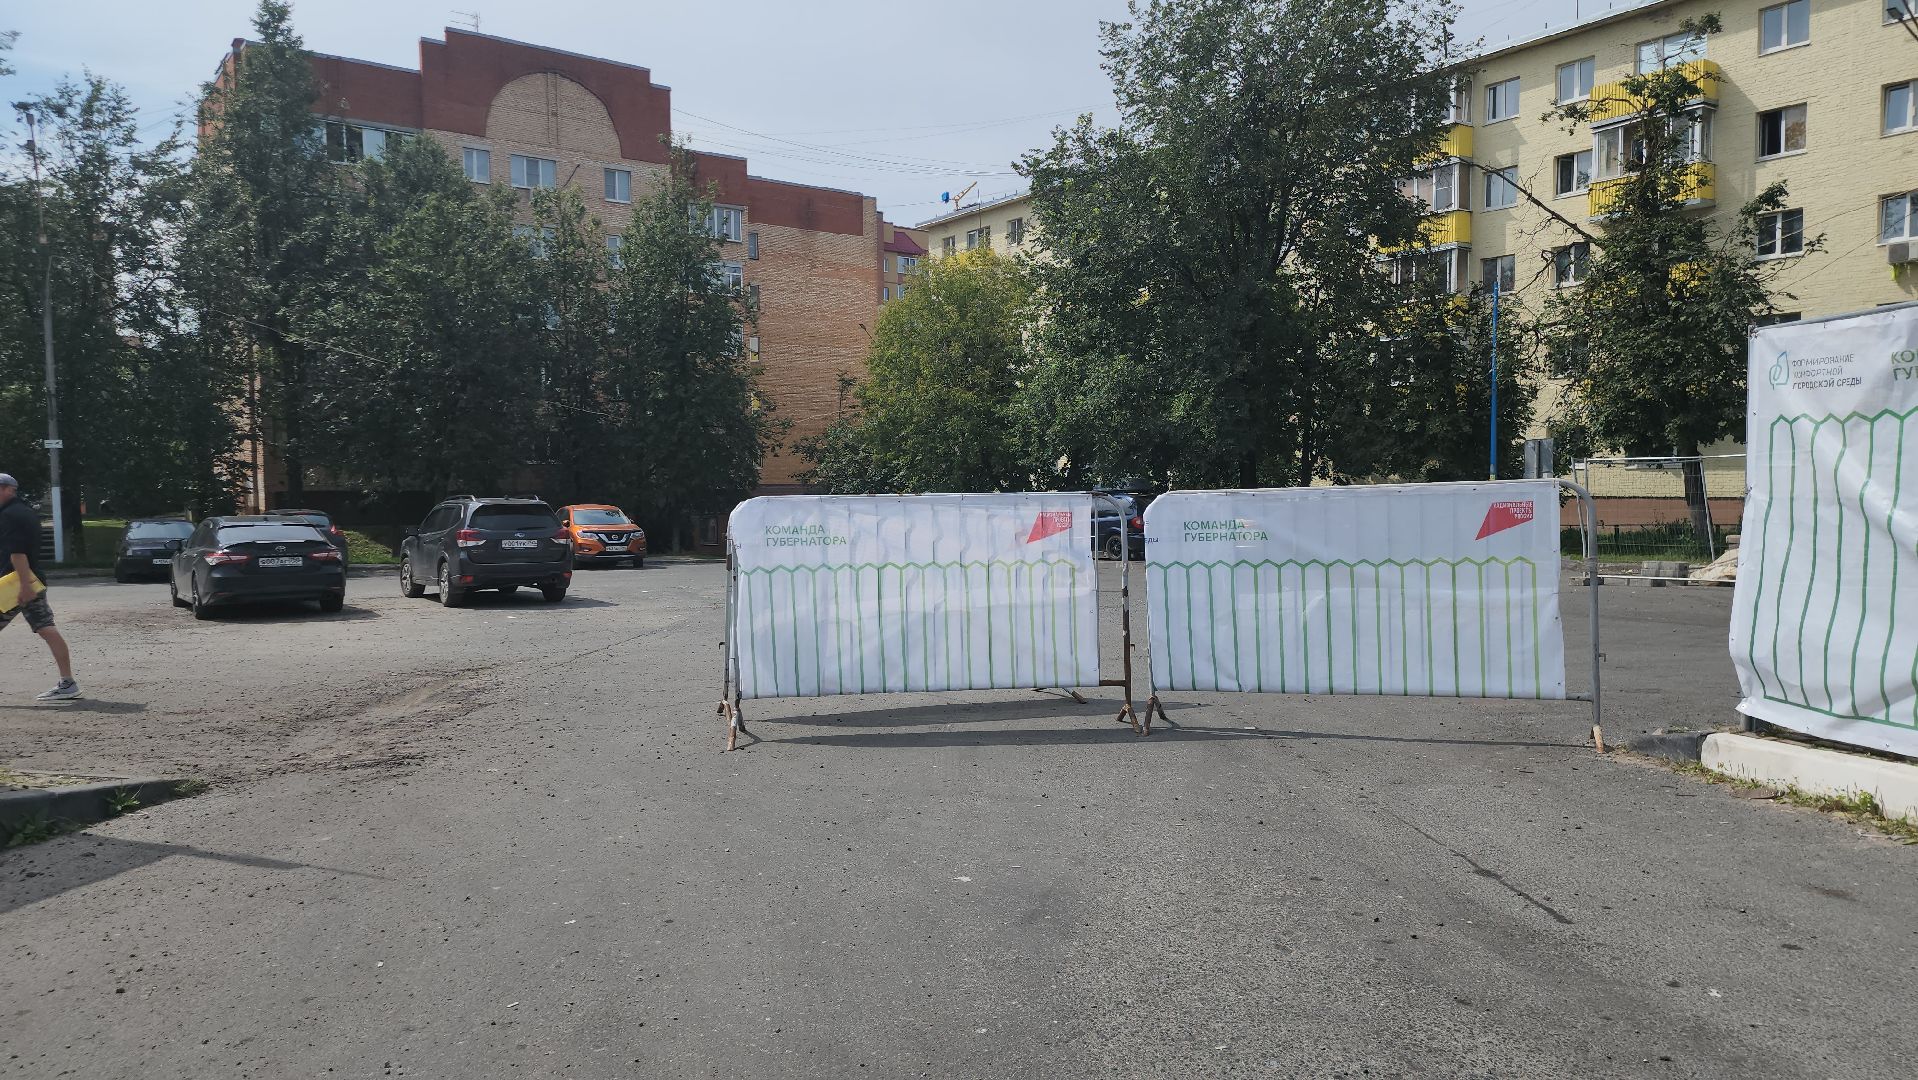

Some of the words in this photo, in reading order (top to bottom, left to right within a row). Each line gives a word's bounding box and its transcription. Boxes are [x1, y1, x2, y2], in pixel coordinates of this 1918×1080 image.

[1791, 353, 1854, 367] ФОРМИРОВАНИЕ
[1891, 350, 1918, 363] КО
[1792, 378, 1835, 390] ГОРОДСКОЙ
[1836, 377, 1862, 388] СРЕДЫ
[765, 524, 825, 535] КОМАНДА
[1183, 519, 1246, 531] КОМАНДА
[766, 536, 847, 547] ГУБЕРНАТОРА
[1184, 531, 1268, 543] ГУБЕРНАТОРА
